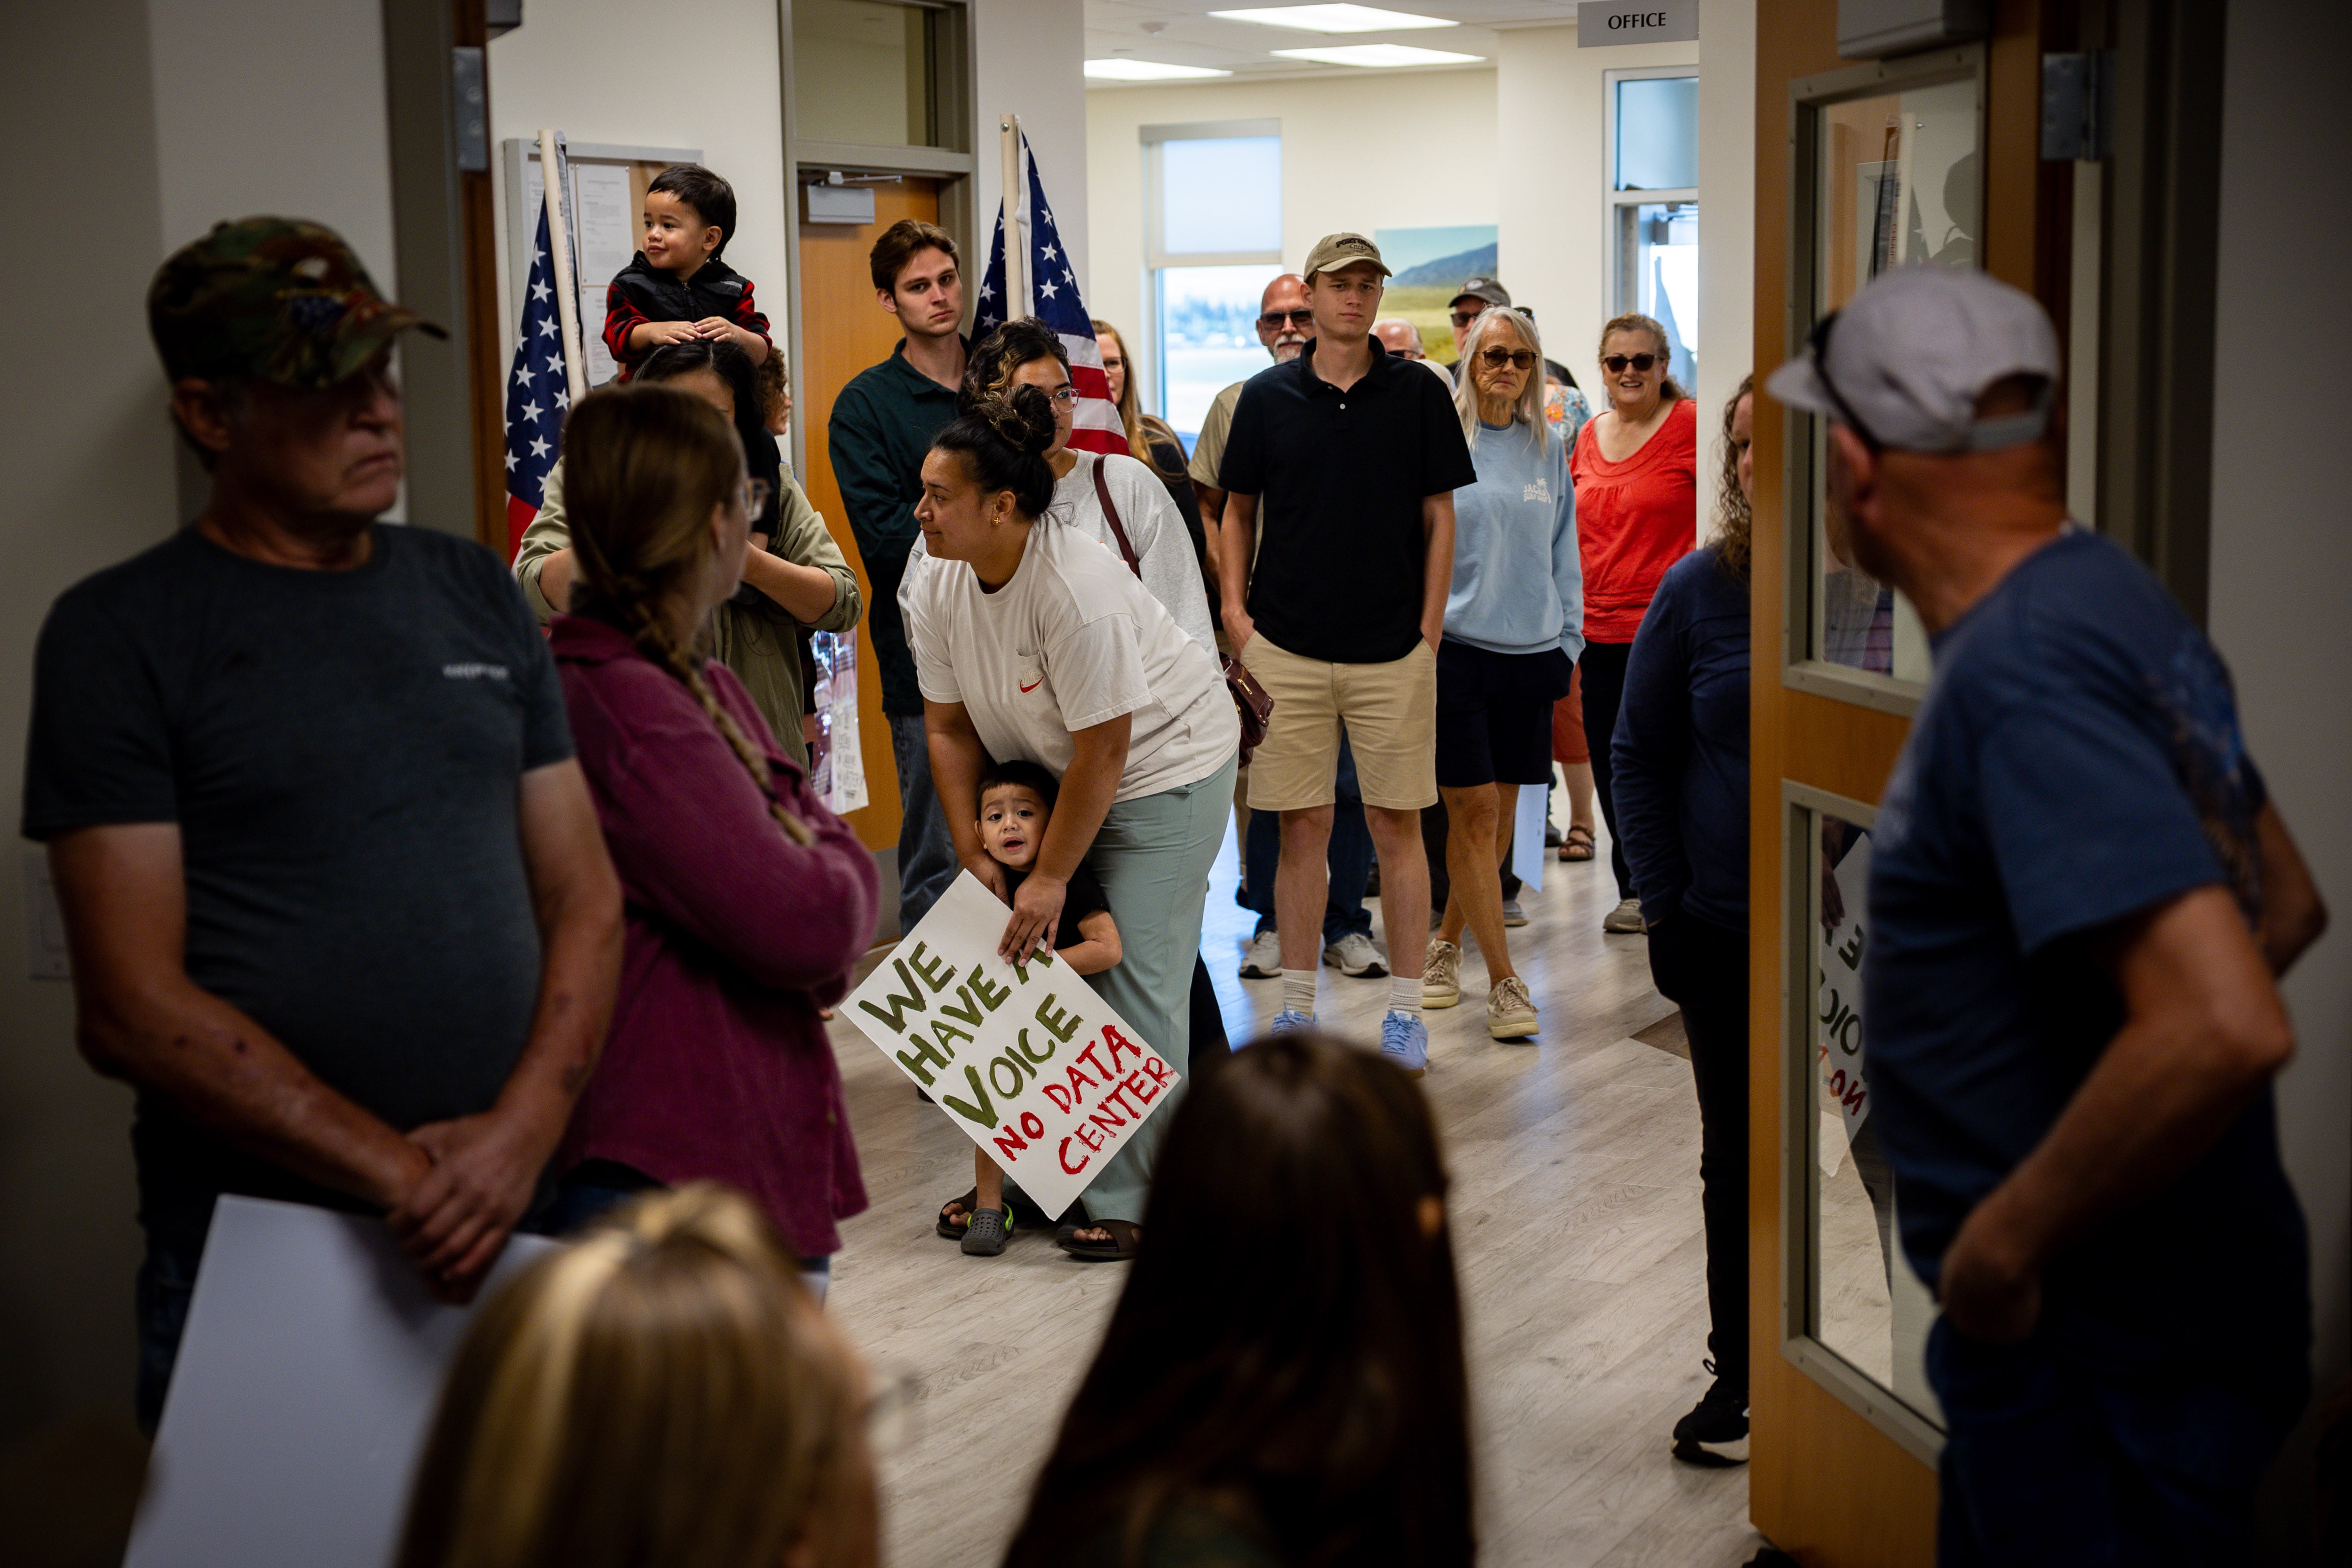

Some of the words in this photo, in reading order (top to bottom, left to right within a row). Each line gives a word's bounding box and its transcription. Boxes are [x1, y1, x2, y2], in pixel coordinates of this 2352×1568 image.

[1608, 12, 1666, 29] OFFICE
[858, 941, 958, 1035] WE
[896, 963, 1012, 1087] HAVE
[942, 993, 1084, 1130] VOICE
[993, 1111, 1044, 1162] NO
[1042, 1025, 1141, 1114] DATA
[1058, 1057, 1176, 1175] CENTER
